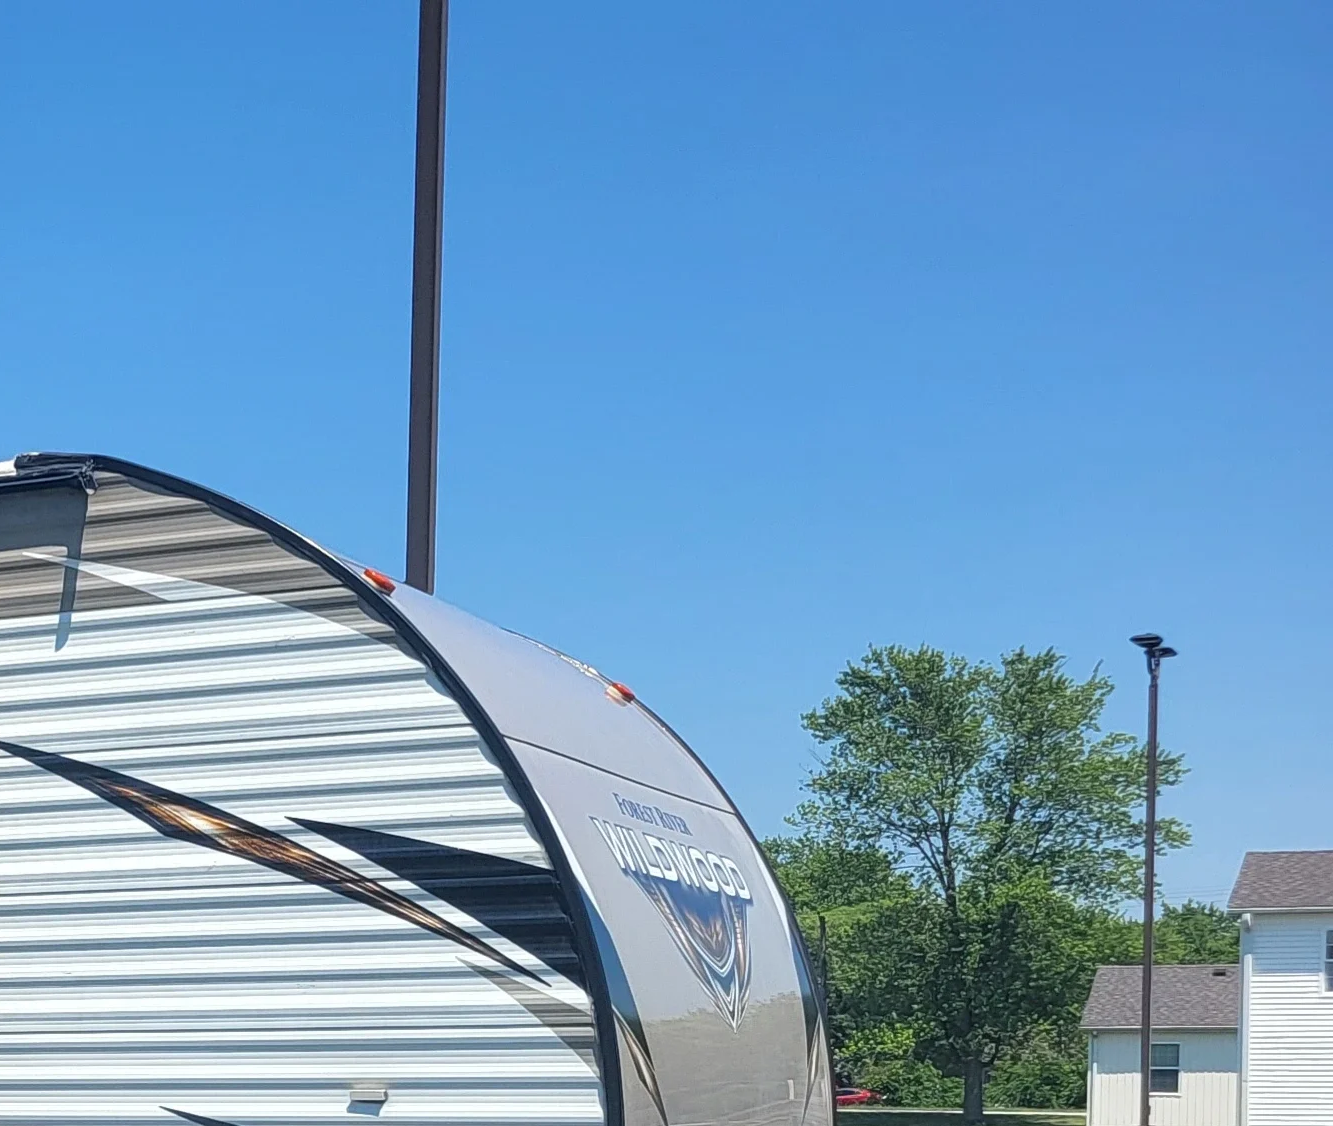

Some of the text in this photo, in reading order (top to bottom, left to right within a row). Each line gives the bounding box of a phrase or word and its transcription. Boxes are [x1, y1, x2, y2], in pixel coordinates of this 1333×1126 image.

[612, 792, 693, 836] FOREST RIVER
[588, 816, 752, 901] WILDWOOD
